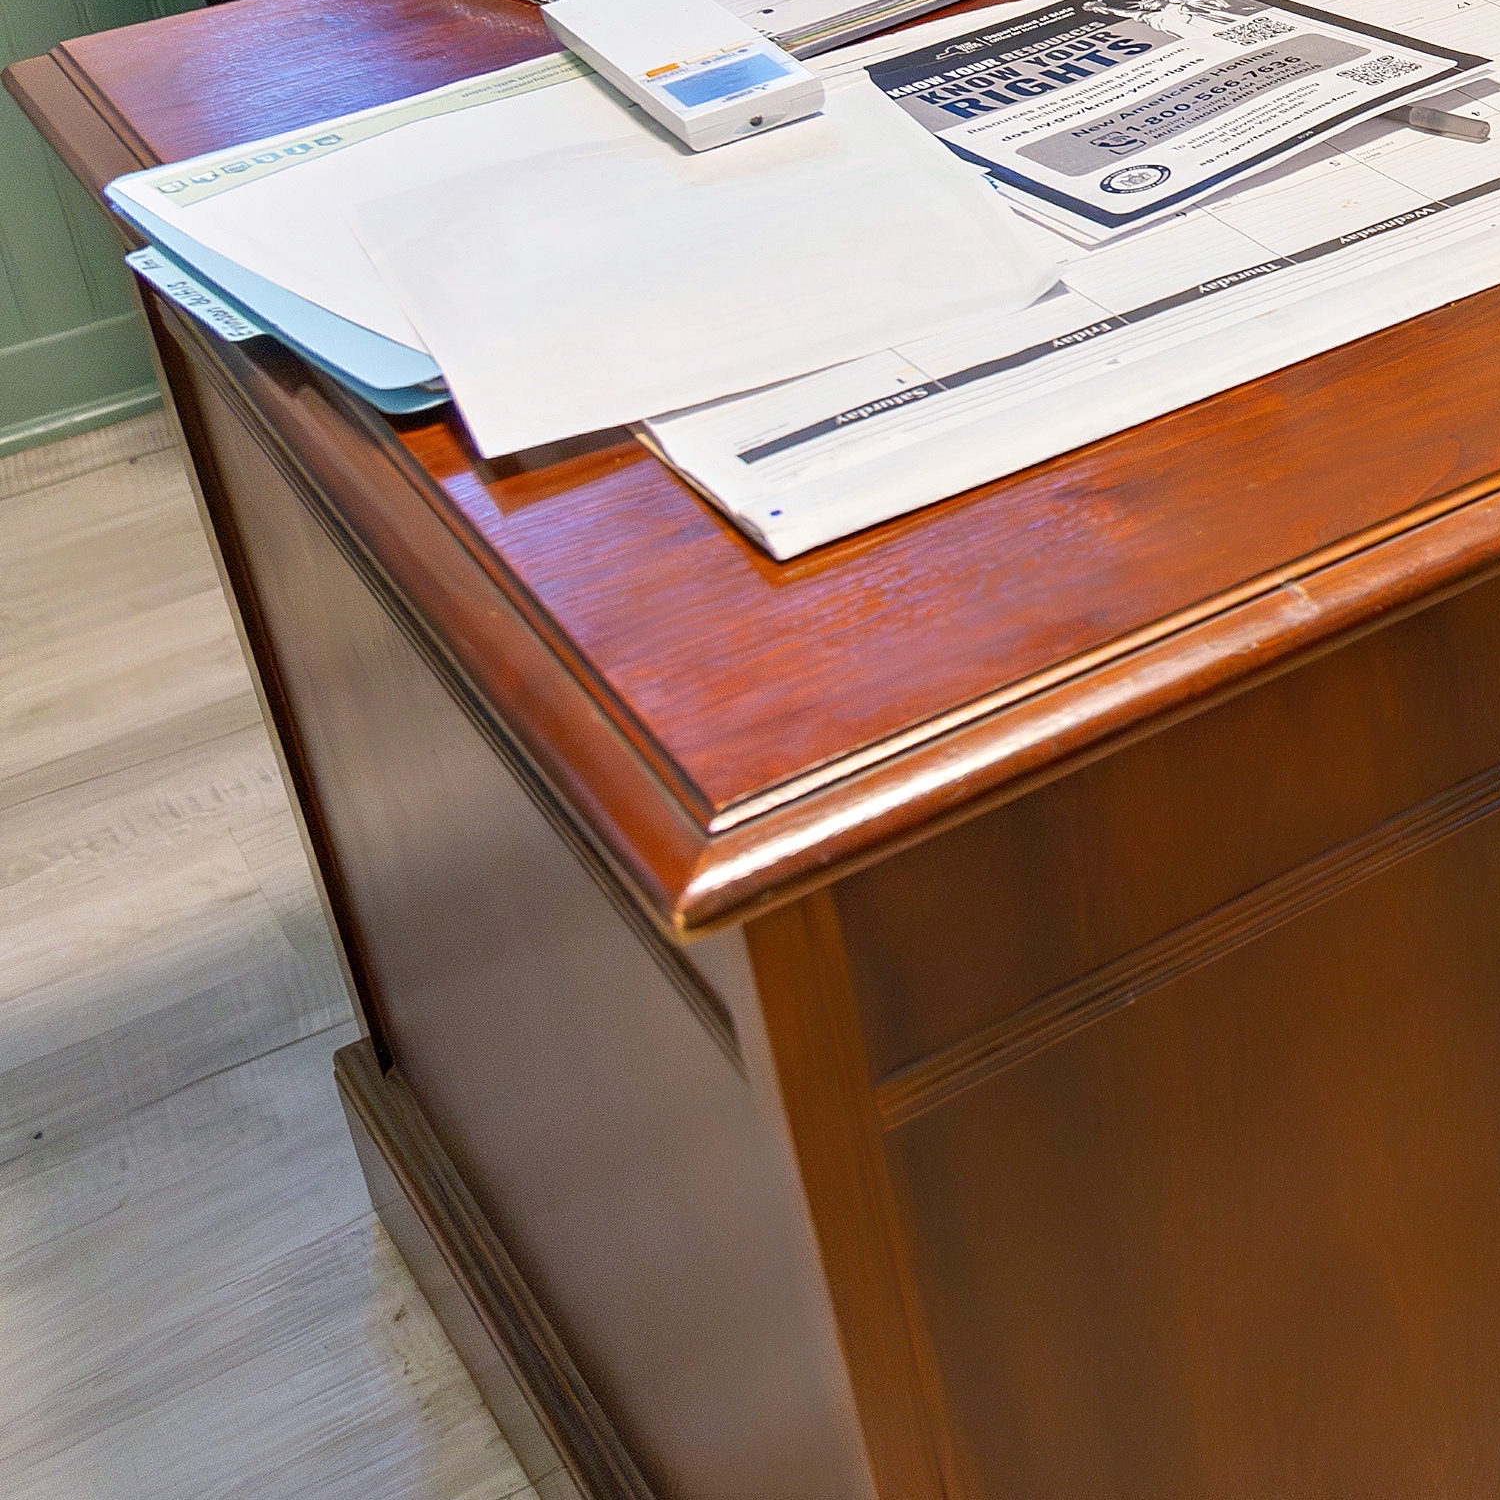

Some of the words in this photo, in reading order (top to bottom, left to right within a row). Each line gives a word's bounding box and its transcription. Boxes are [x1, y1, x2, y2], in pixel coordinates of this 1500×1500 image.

[1455, 0, 1472, 10] 17
[982, 18, 1040, 41] Department
[886, 75, 946, 99] KNOW
[946, 55, 1001, 83] YOUR
[1000, 20, 1107, 63] RESOURCES
[916, 66, 1022, 105] KNOW
[1025, 30, 1124, 68] YOUR
[938, 38, 1153, 120] RIGHTS
[967, 109, 1036, 135] Resources
[1060, 81, 1114, 104] available
[1001, 57, 1206, 142] dos.ny.gov/know-your-rights
[1025, 97, 1085, 122] including
[1071, 118, 1115, 138] New
[1117, 76, 1210, 121] Americans
[1210, 49, 1279, 77] Hotline:
[1126, 56, 1301, 132] 1-800-566-7636
[1339, 206, 1437, 245] Wednesday
[1198, 263, 1281, 295] Thursday
[1052, 322, 1111, 349] Friday
[835, 386, 929, 427] Saturday
